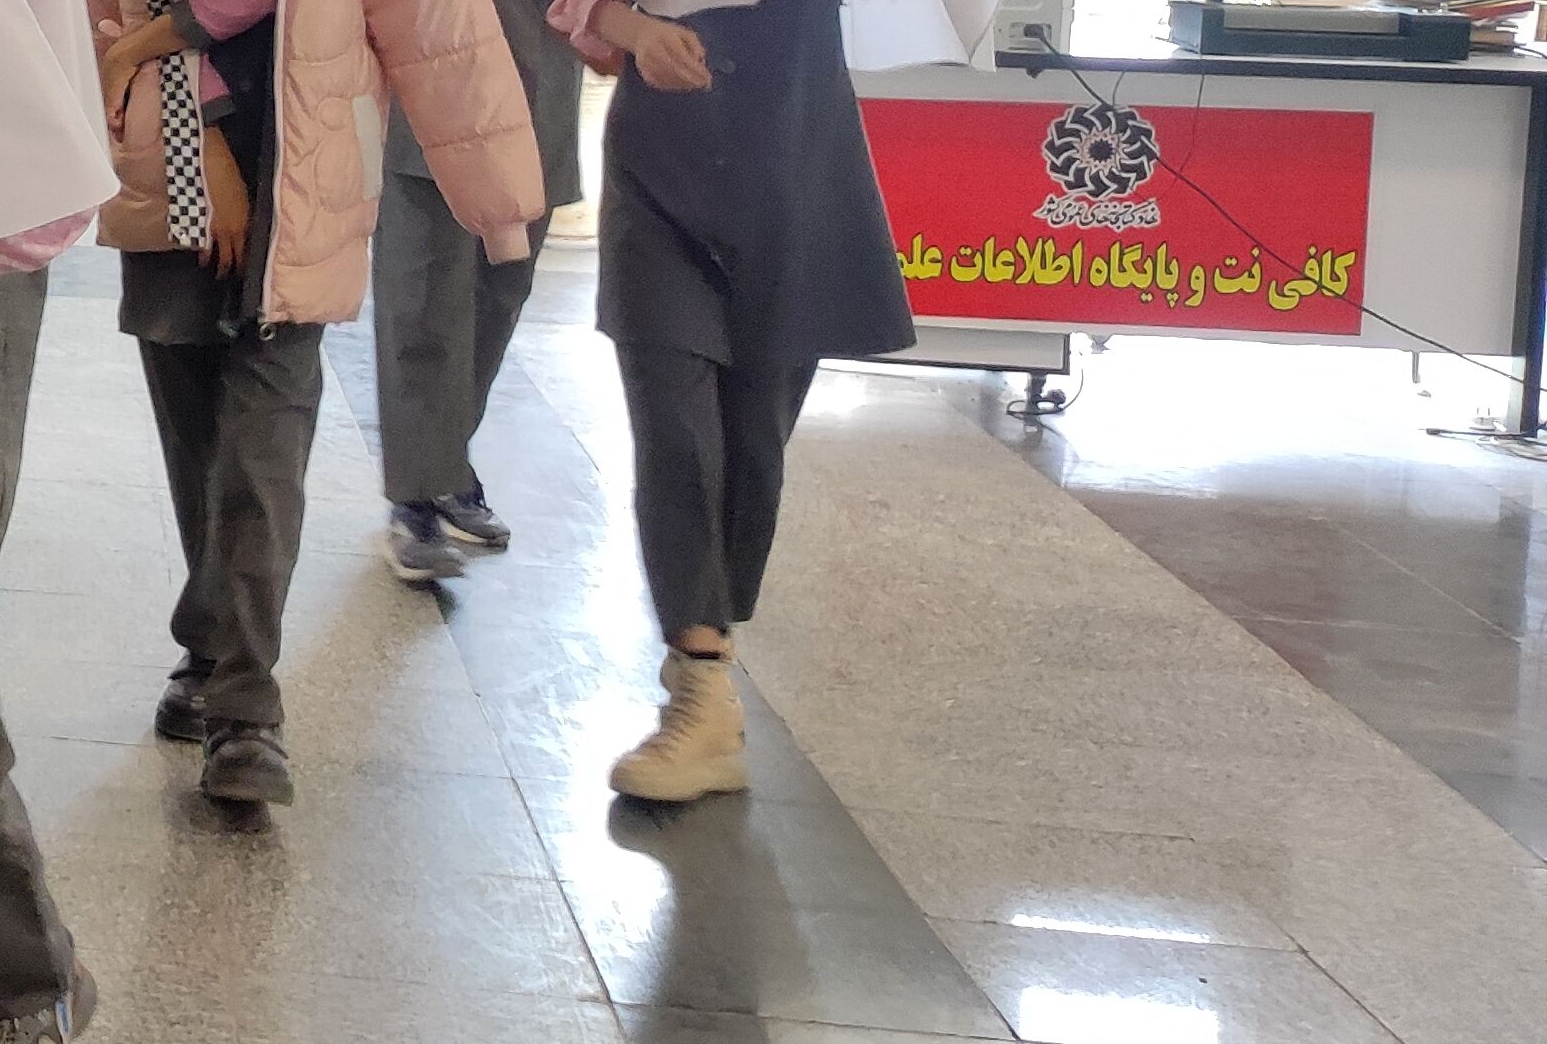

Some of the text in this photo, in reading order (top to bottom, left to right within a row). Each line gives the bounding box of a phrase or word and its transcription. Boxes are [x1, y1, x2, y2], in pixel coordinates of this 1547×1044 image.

[896, 232, 1357, 311] کافی نت و پایگاه اطلاعات علم
